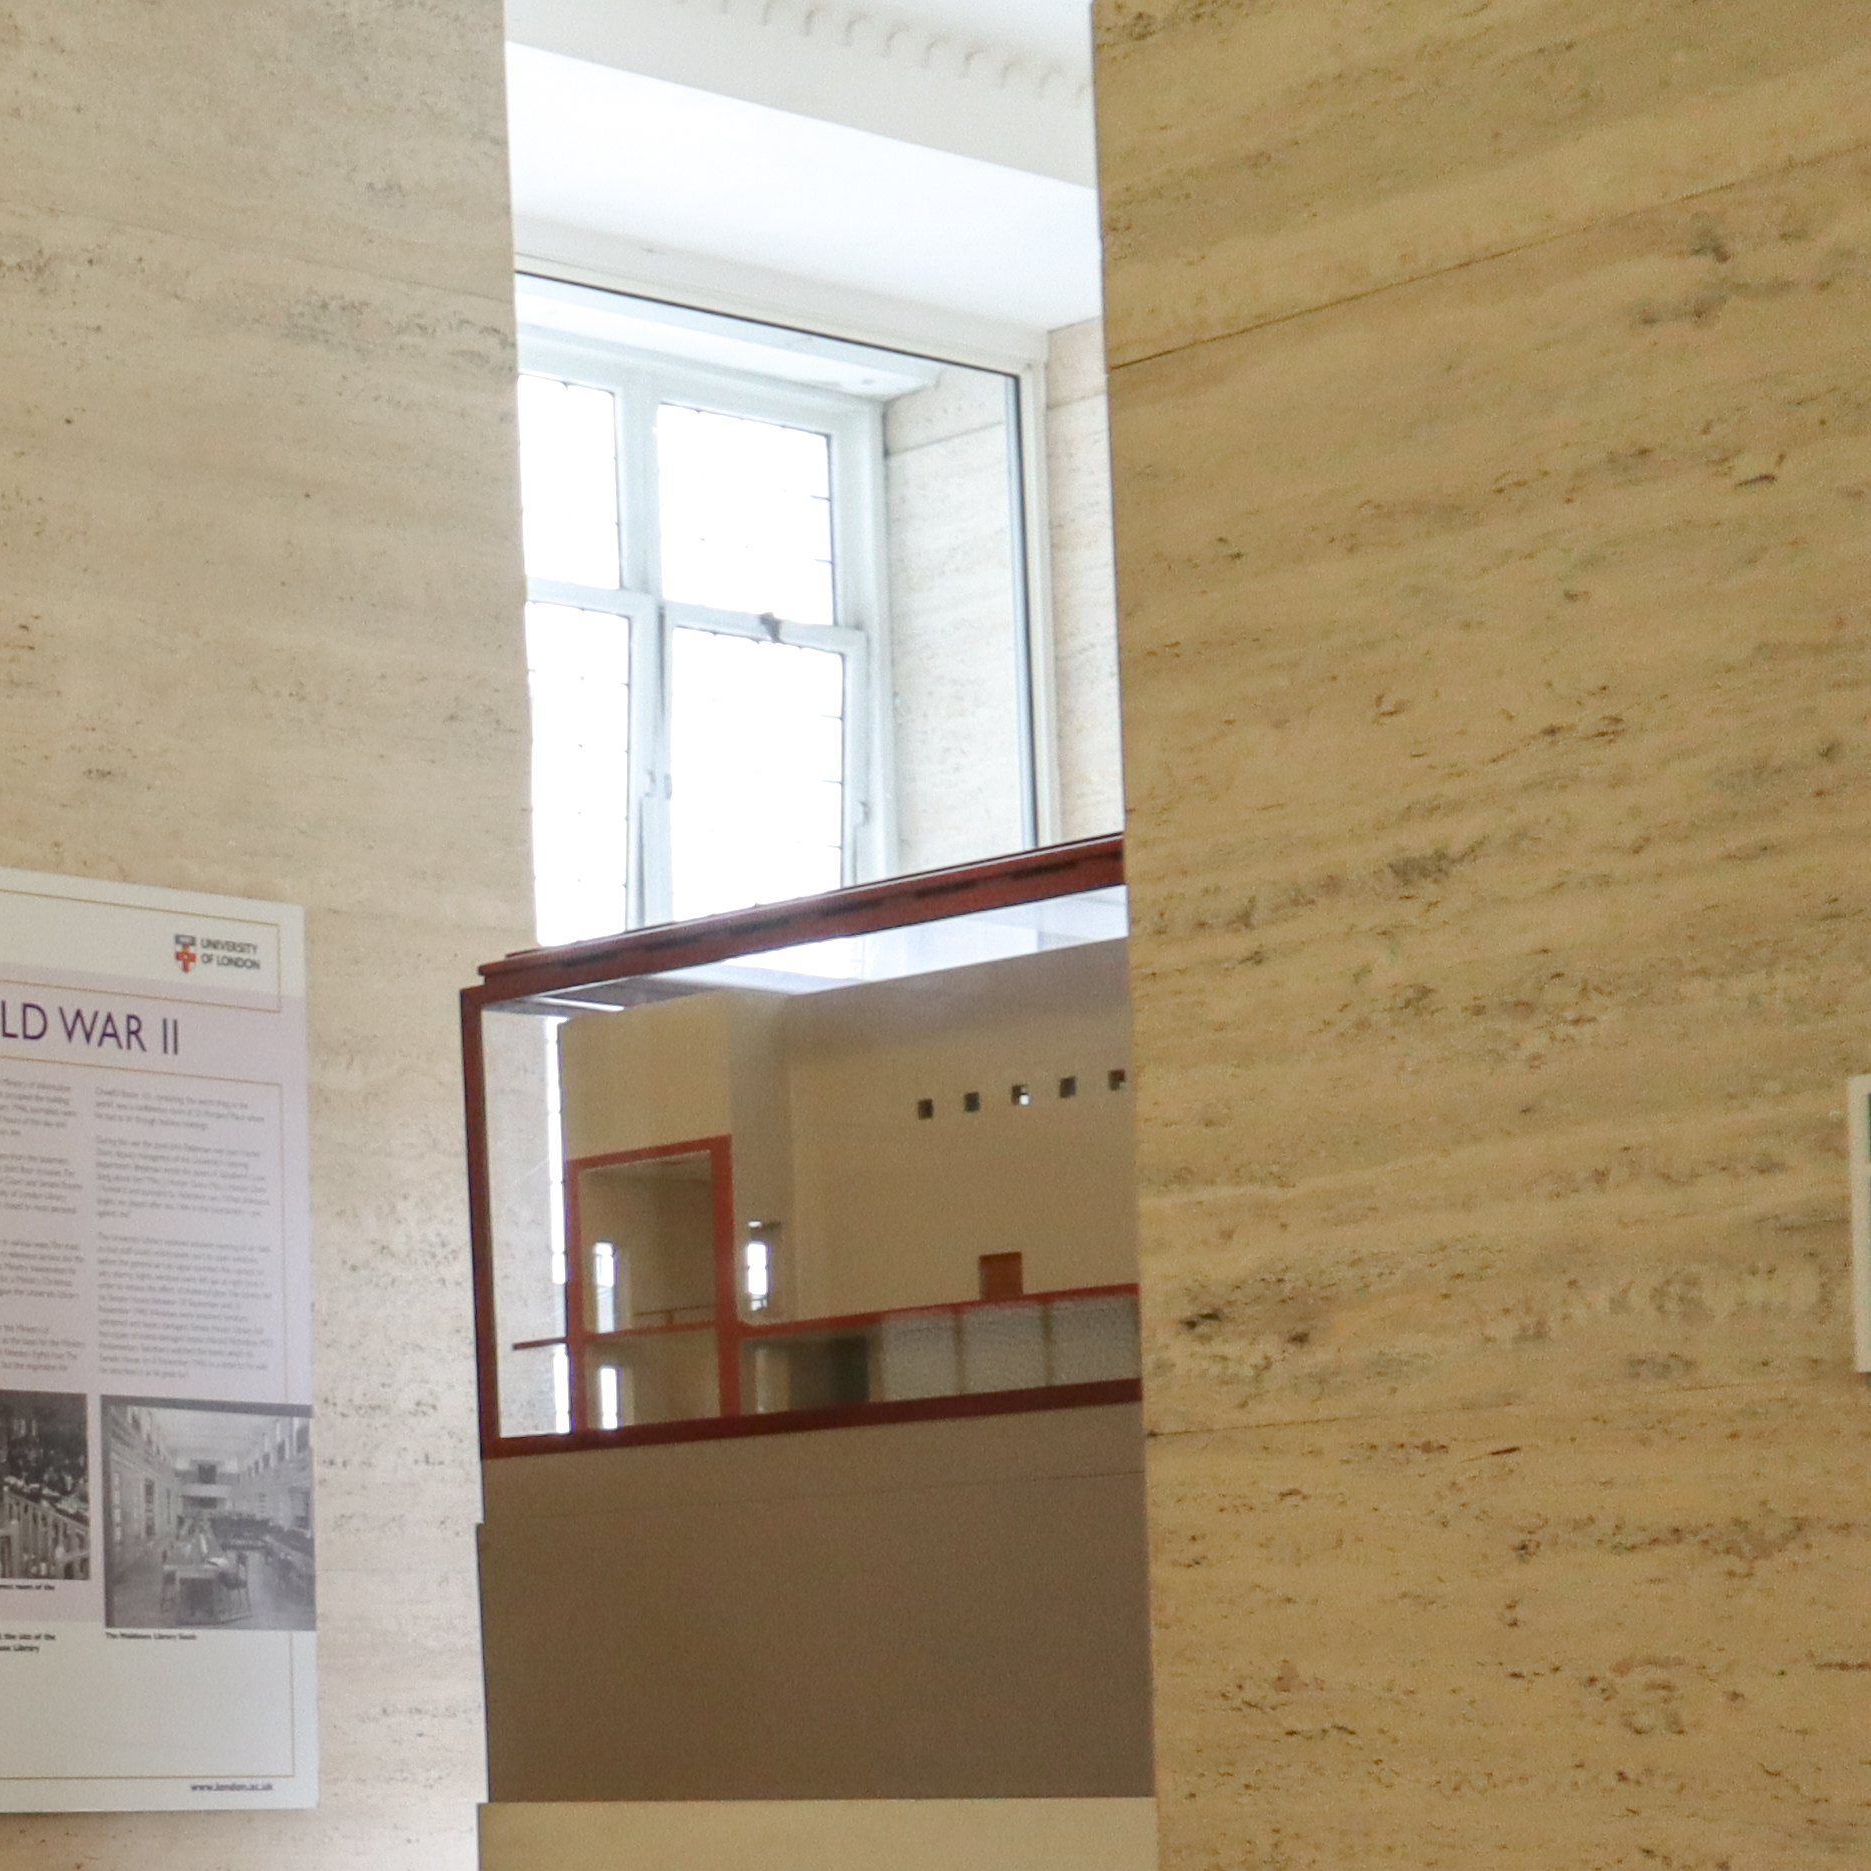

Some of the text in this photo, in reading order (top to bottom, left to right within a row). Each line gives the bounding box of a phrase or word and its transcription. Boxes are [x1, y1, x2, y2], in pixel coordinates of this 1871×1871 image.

[200, 938, 258, 954] UNIVERSITY
[200, 952, 261, 969] OF LONDON
[59, 1007, 147, 1052] WAR
[161, 1017, 179, 1056] II
